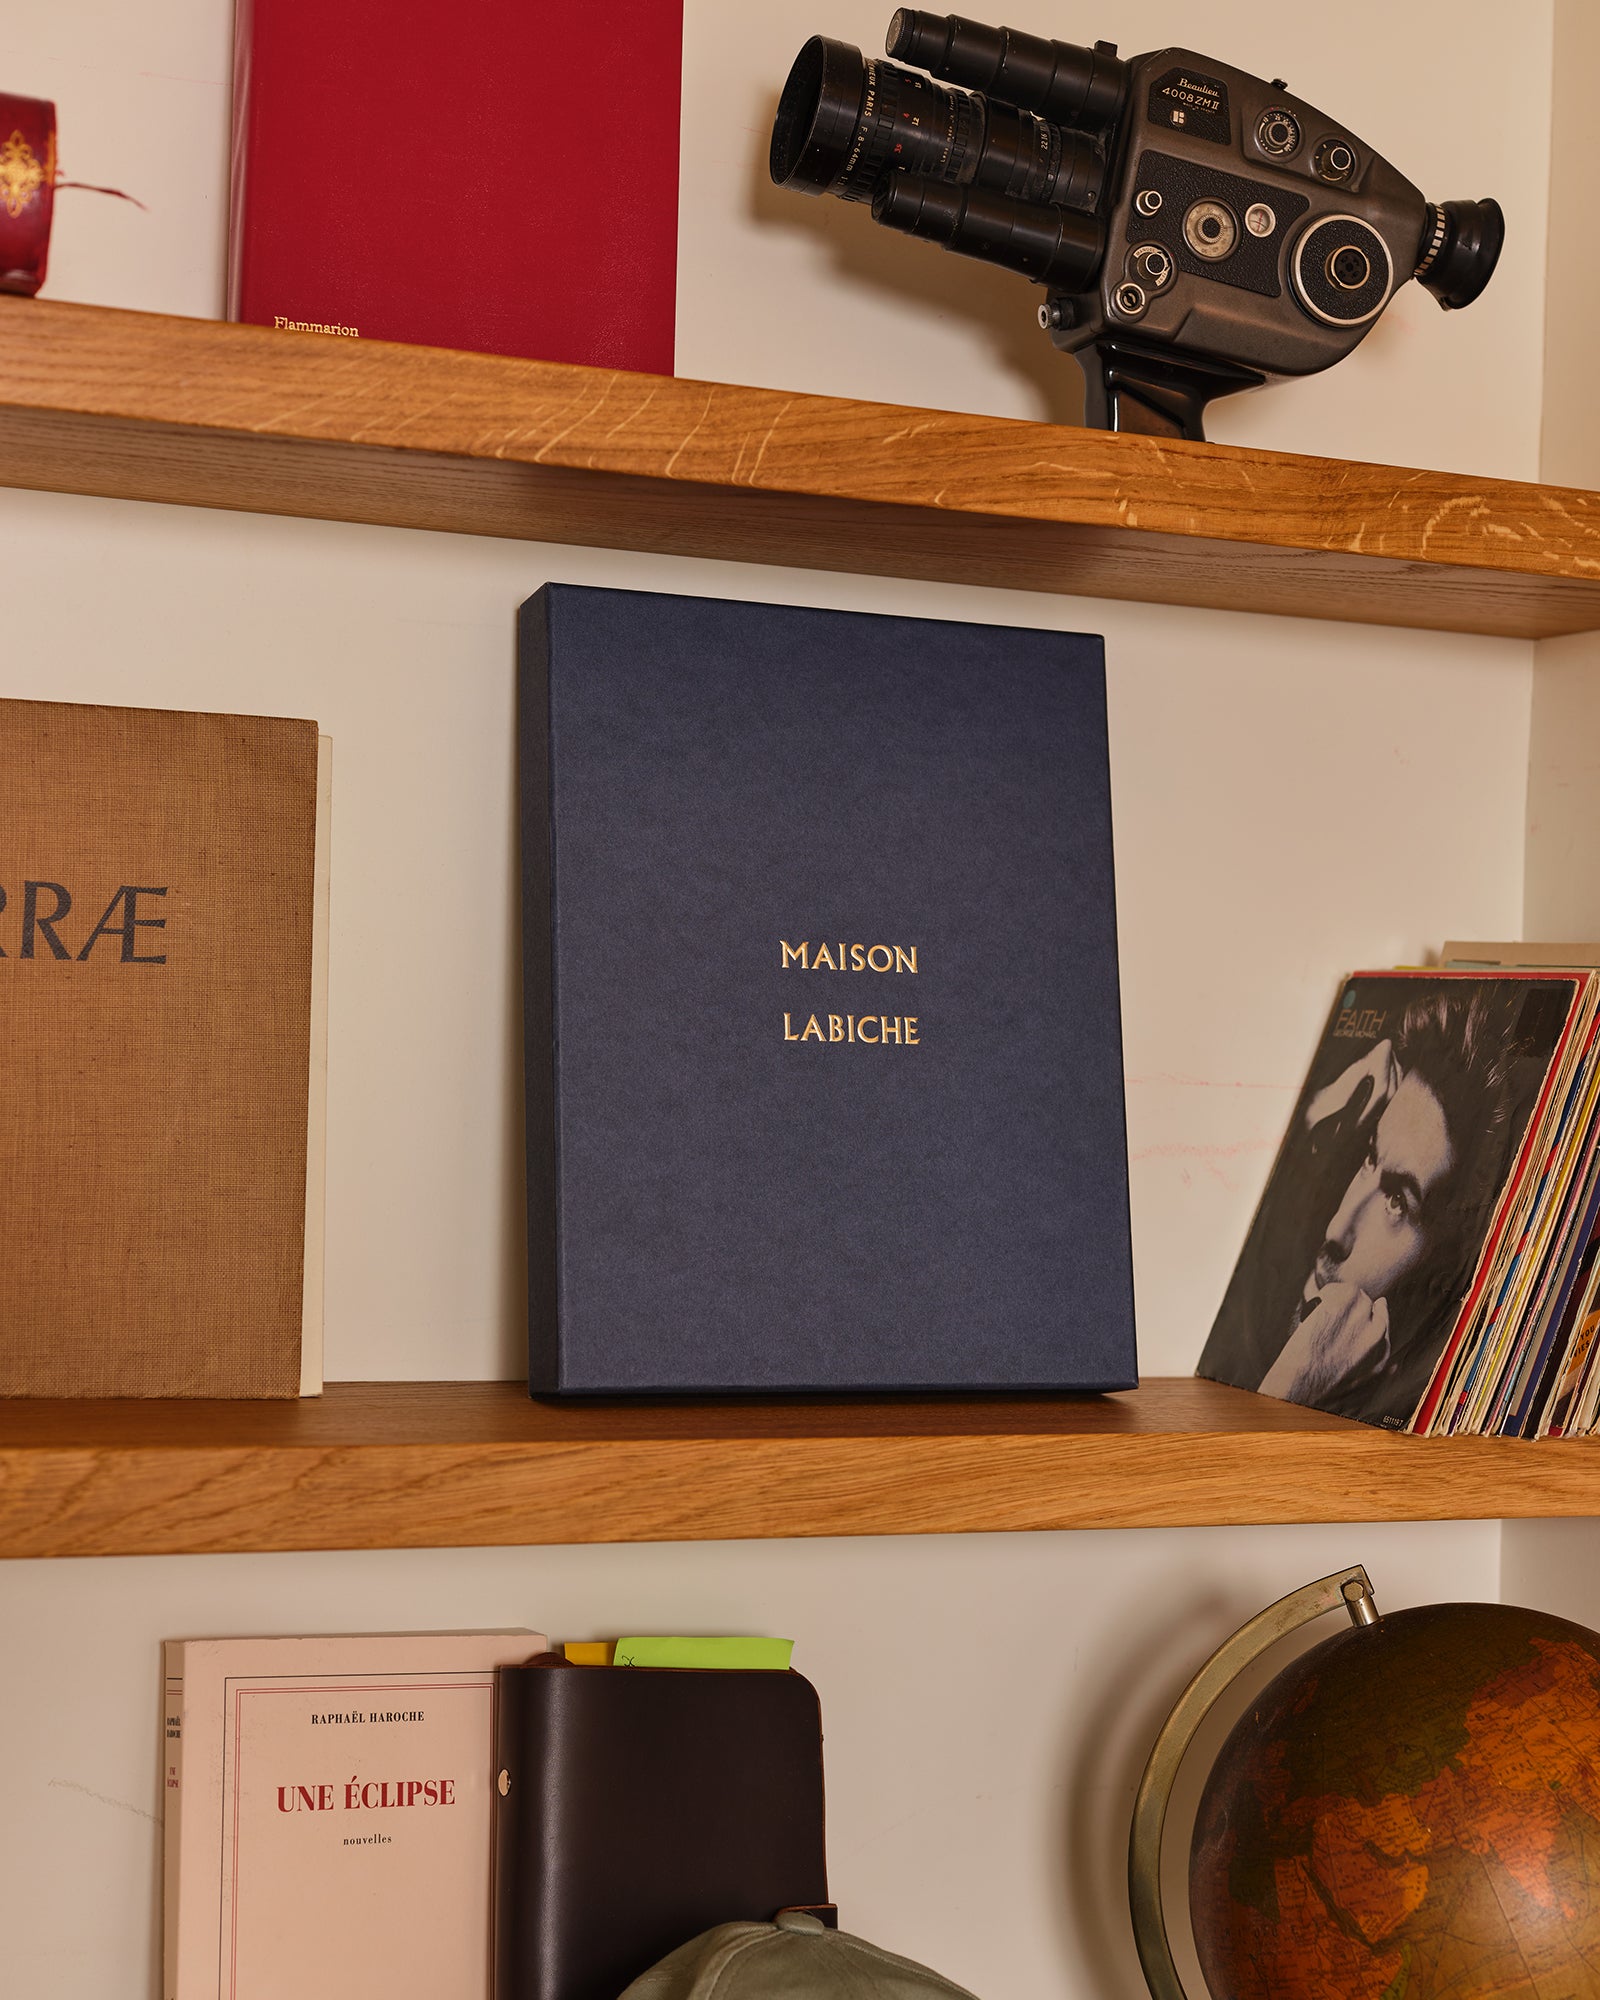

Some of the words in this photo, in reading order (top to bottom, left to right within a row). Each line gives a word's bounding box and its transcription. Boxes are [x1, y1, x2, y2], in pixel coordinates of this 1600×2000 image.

[1177, 77, 1220, 97] Beaulieu
[864, 89, 876, 118] PARIS
[274, 316, 359, 337] Flammarion
[0, 880, 168, 964] RÆ
[779, 940, 918, 974] MAISON
[783, 1012, 921, 1045] LABICHE
[1333, 1009, 1387, 1033] FAITH
[1580, 1325, 1595, 1340] YOU
[311, 1711, 366, 1724] RAPHAËL
[369, 1711, 425, 1723] HAROCHE
[277, 1785, 334, 1813] UNE
[343, 1775, 456, 1809] ÉCLIPSE
[343, 1834, 392, 1845] nouvelles
